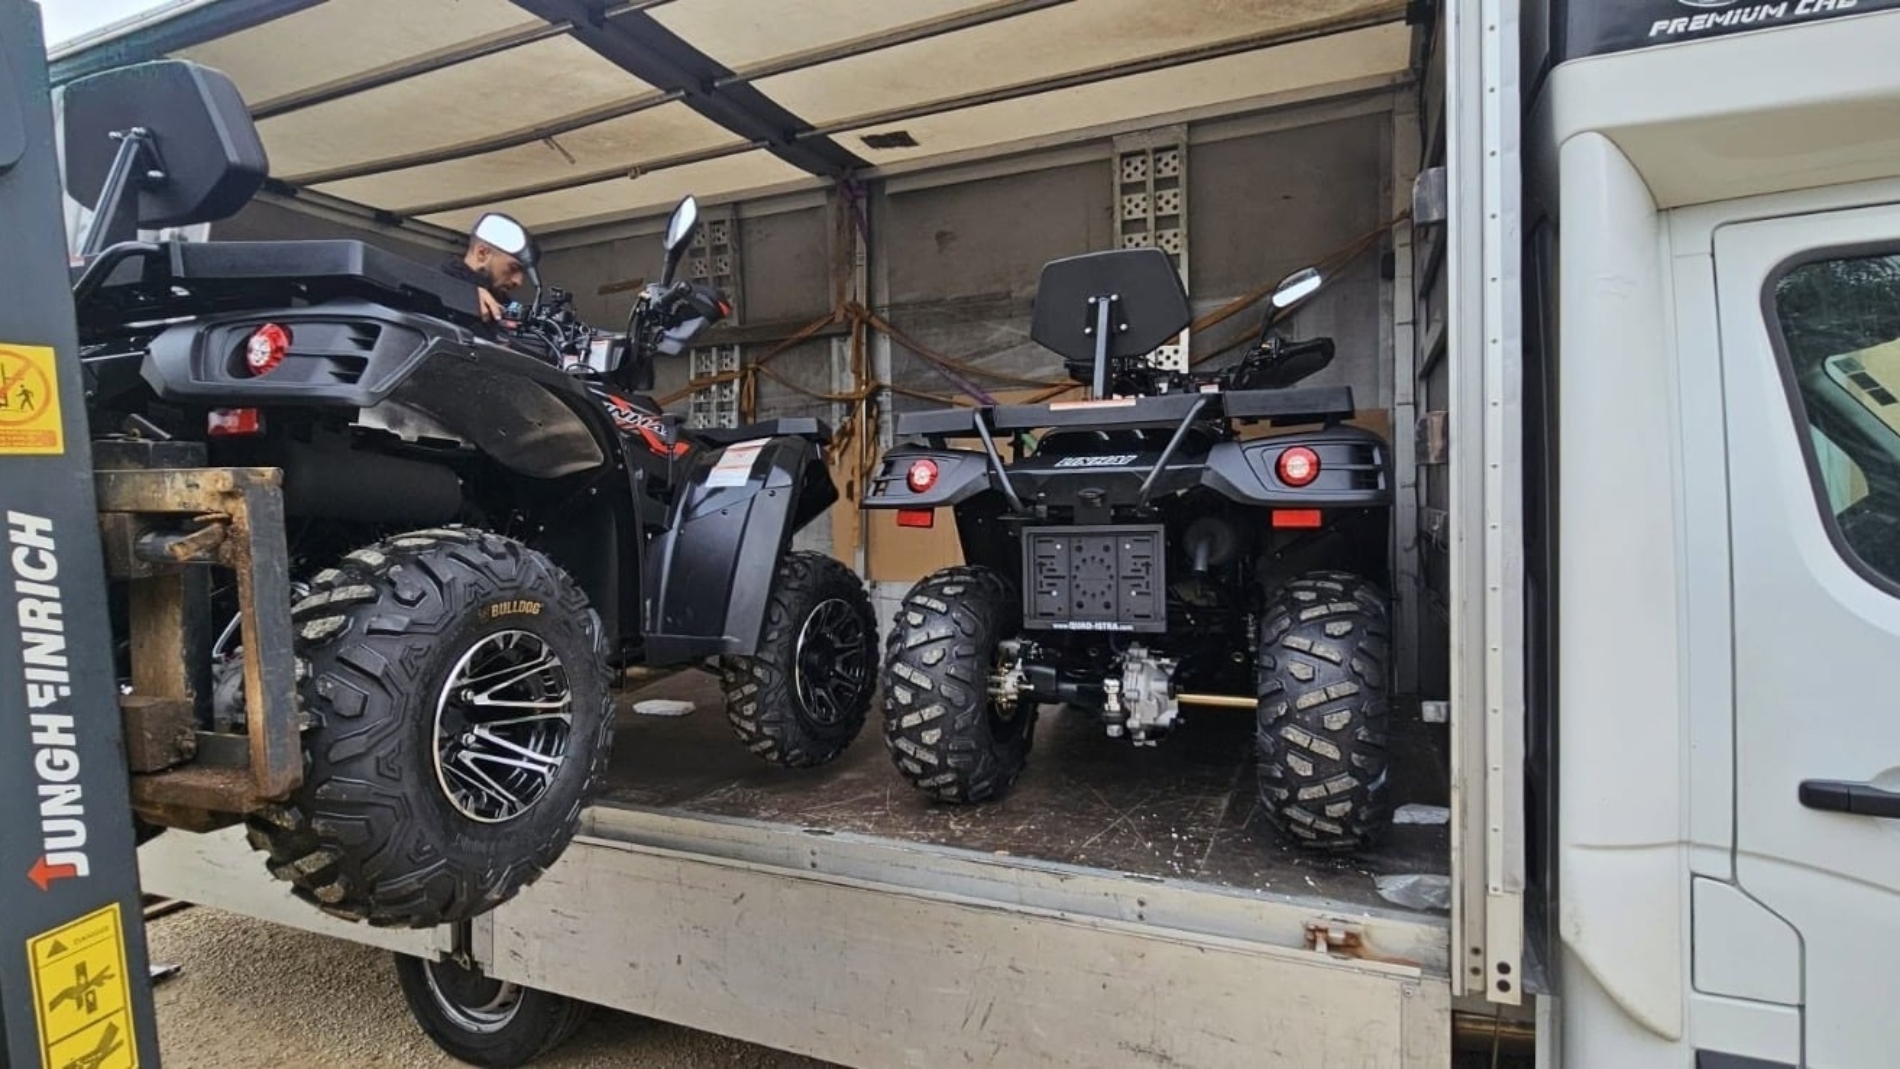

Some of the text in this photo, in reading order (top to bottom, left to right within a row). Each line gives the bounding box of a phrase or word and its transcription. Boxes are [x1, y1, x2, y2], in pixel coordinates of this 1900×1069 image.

[1648, 2, 1788, 37] PREMIUM
[491, 599, 541, 618] BULLDOG
[7, 510, 90, 877] JUNGHEINRICH
